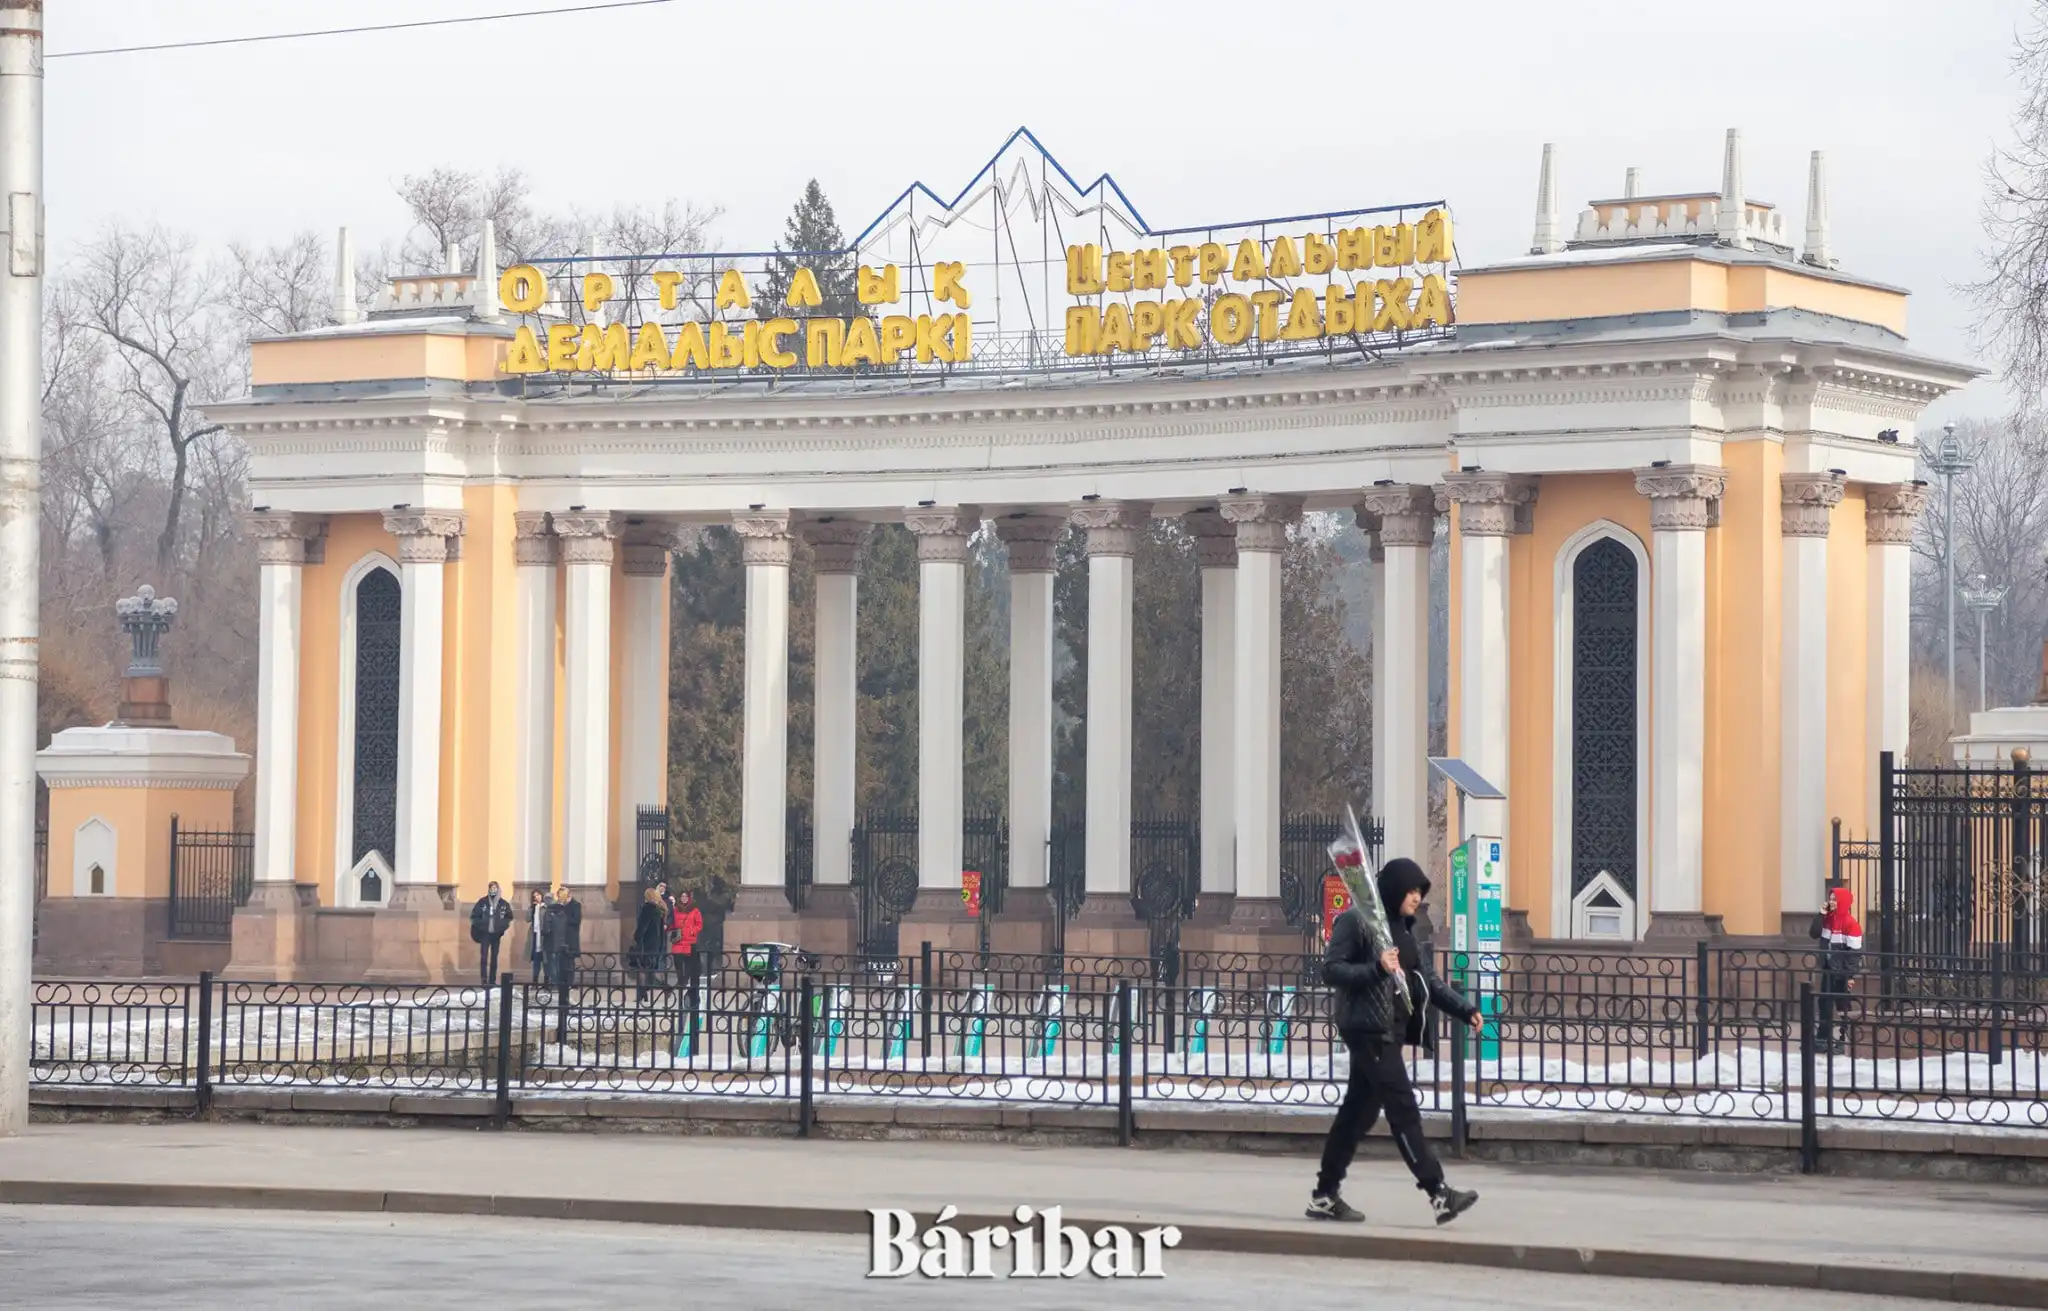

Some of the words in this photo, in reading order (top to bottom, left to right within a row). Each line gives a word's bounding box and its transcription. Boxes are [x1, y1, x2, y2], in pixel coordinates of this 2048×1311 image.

[1066, 208, 1454, 295] ЦЕНТРАЛЬНЫЙ
[501, 318, 798, 374] ДЕМАЛЫС
[806, 312, 973, 369] ПАРКІ
[1066, 298, 1203, 357] ПАРК
[1211, 273, 1456, 346] ОТДЫХА
